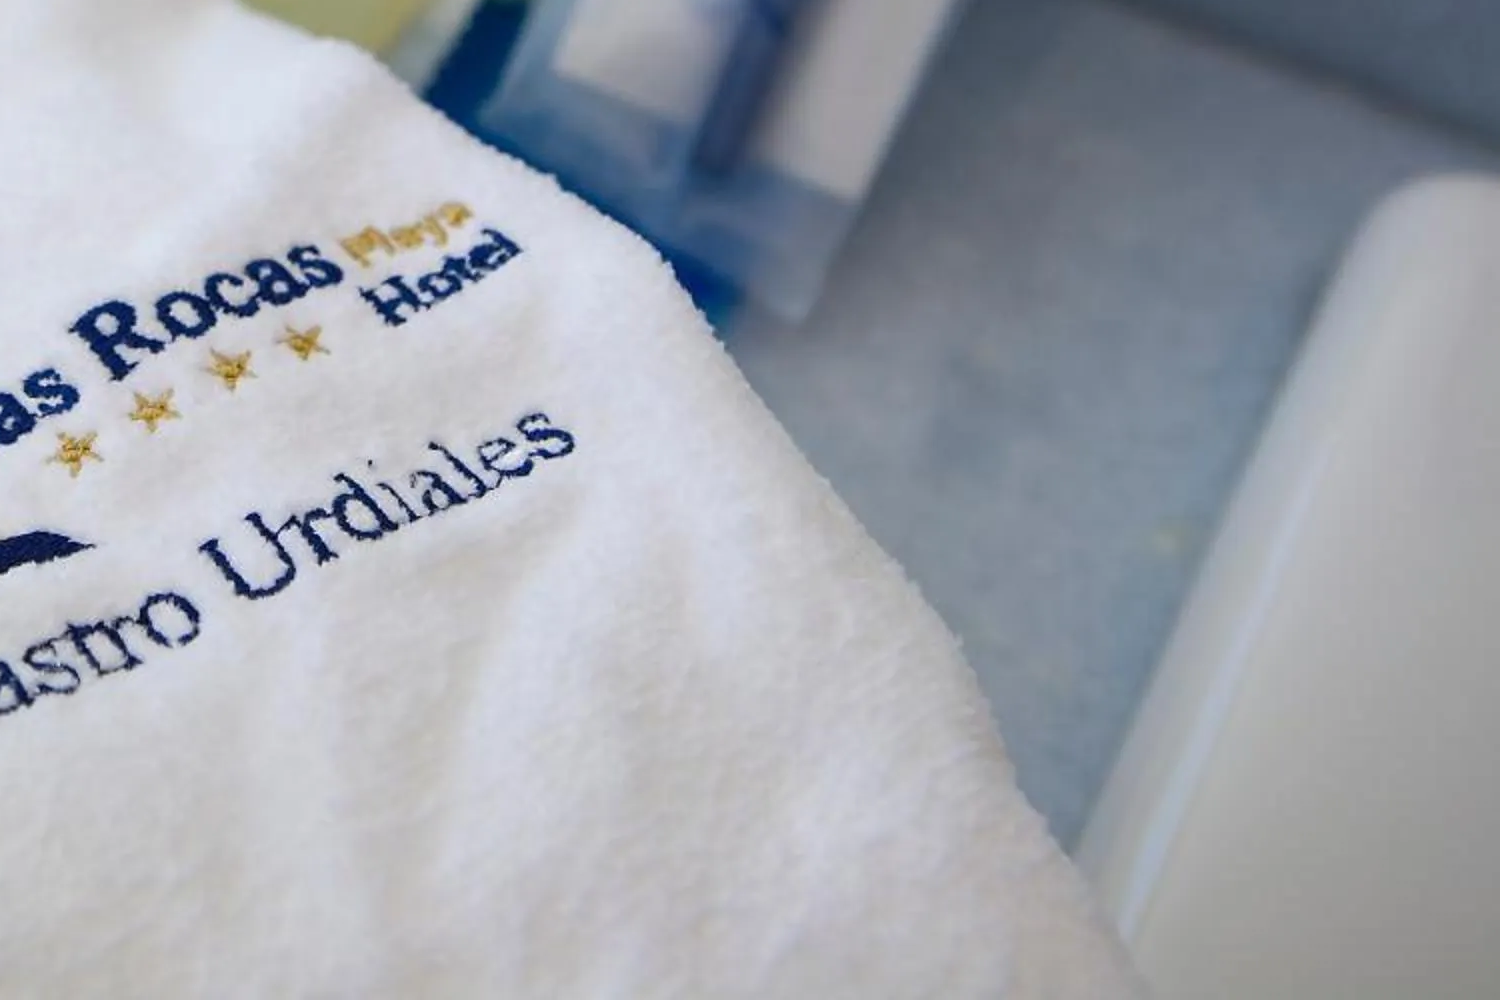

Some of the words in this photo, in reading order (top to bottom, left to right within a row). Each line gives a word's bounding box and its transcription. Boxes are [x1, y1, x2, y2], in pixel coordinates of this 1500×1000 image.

[70, 244, 344, 381] Rocas
[358, 228, 523, 326] Hotel
[199, 412, 576, 599] Urdiales
